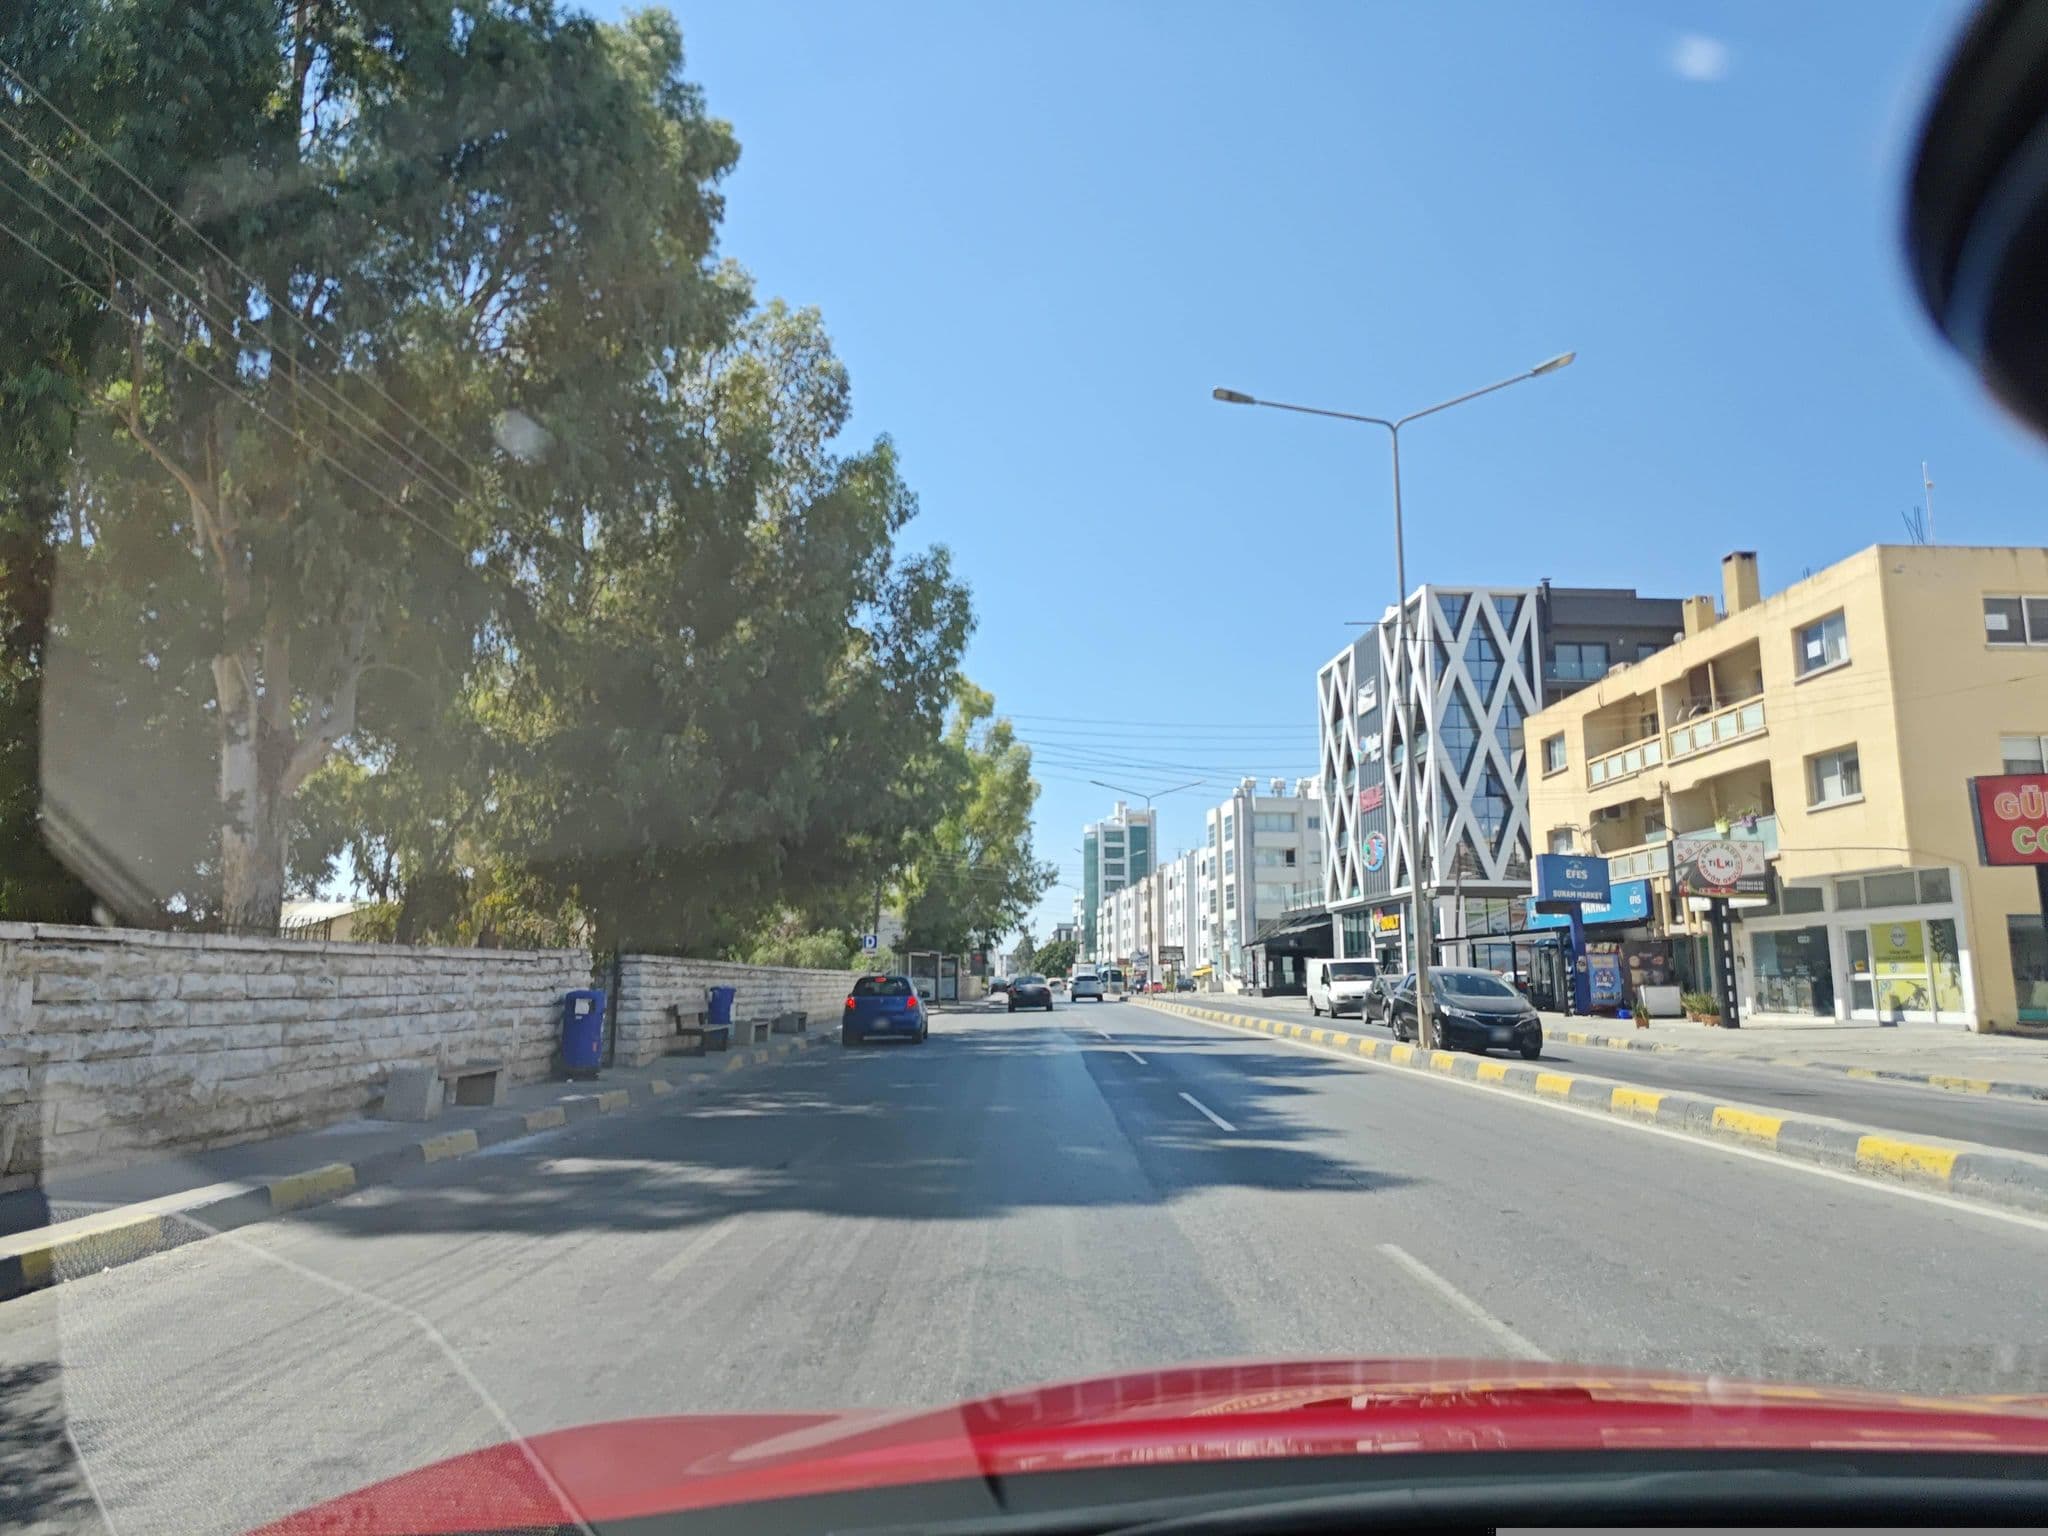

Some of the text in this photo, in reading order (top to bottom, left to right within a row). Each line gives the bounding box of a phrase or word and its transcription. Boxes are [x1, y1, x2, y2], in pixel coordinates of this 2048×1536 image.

[1994, 785, 2048, 820] GÜ
[1566, 868, 1588, 880] EFES
[866, 936, 876, 948] D
